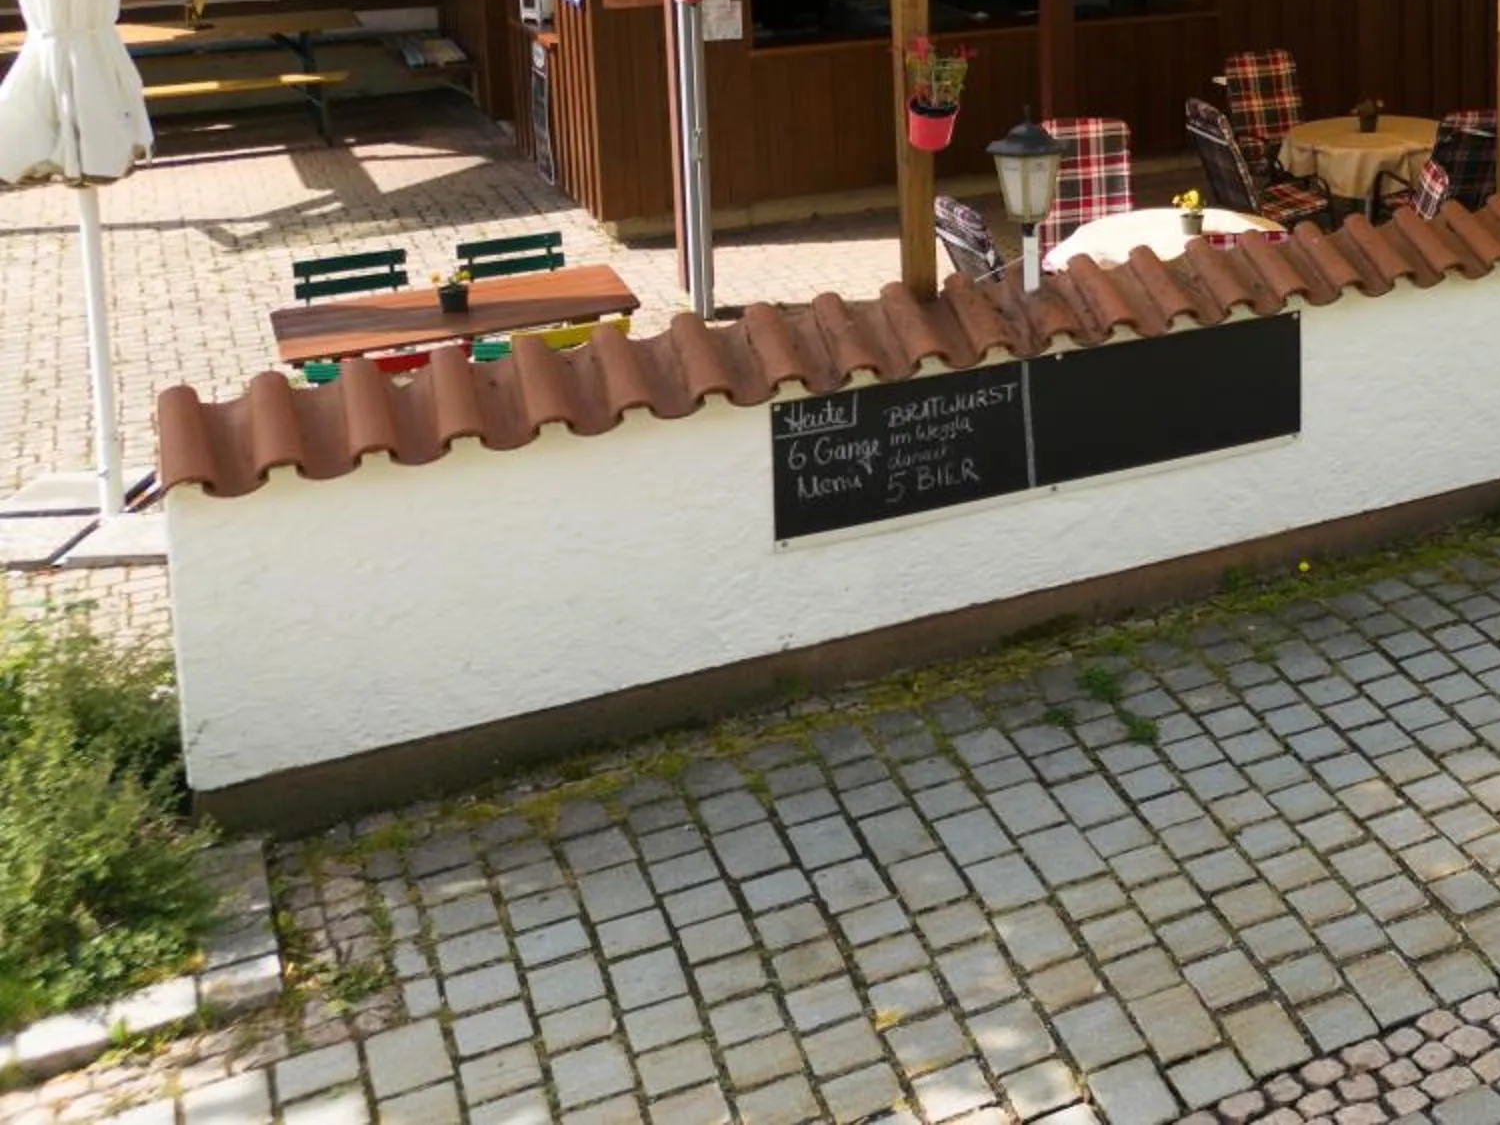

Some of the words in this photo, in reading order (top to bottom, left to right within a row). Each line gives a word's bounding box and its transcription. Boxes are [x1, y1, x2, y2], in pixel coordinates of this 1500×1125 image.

[783, 398, 849, 432] Heute
[883, 382, 1019, 427] BRATWURST
[787, 440, 808, 471] 6
[889, 431, 912, 447] im
[884, 470, 907, 503] 5
[917, 458, 981, 492] BIER
